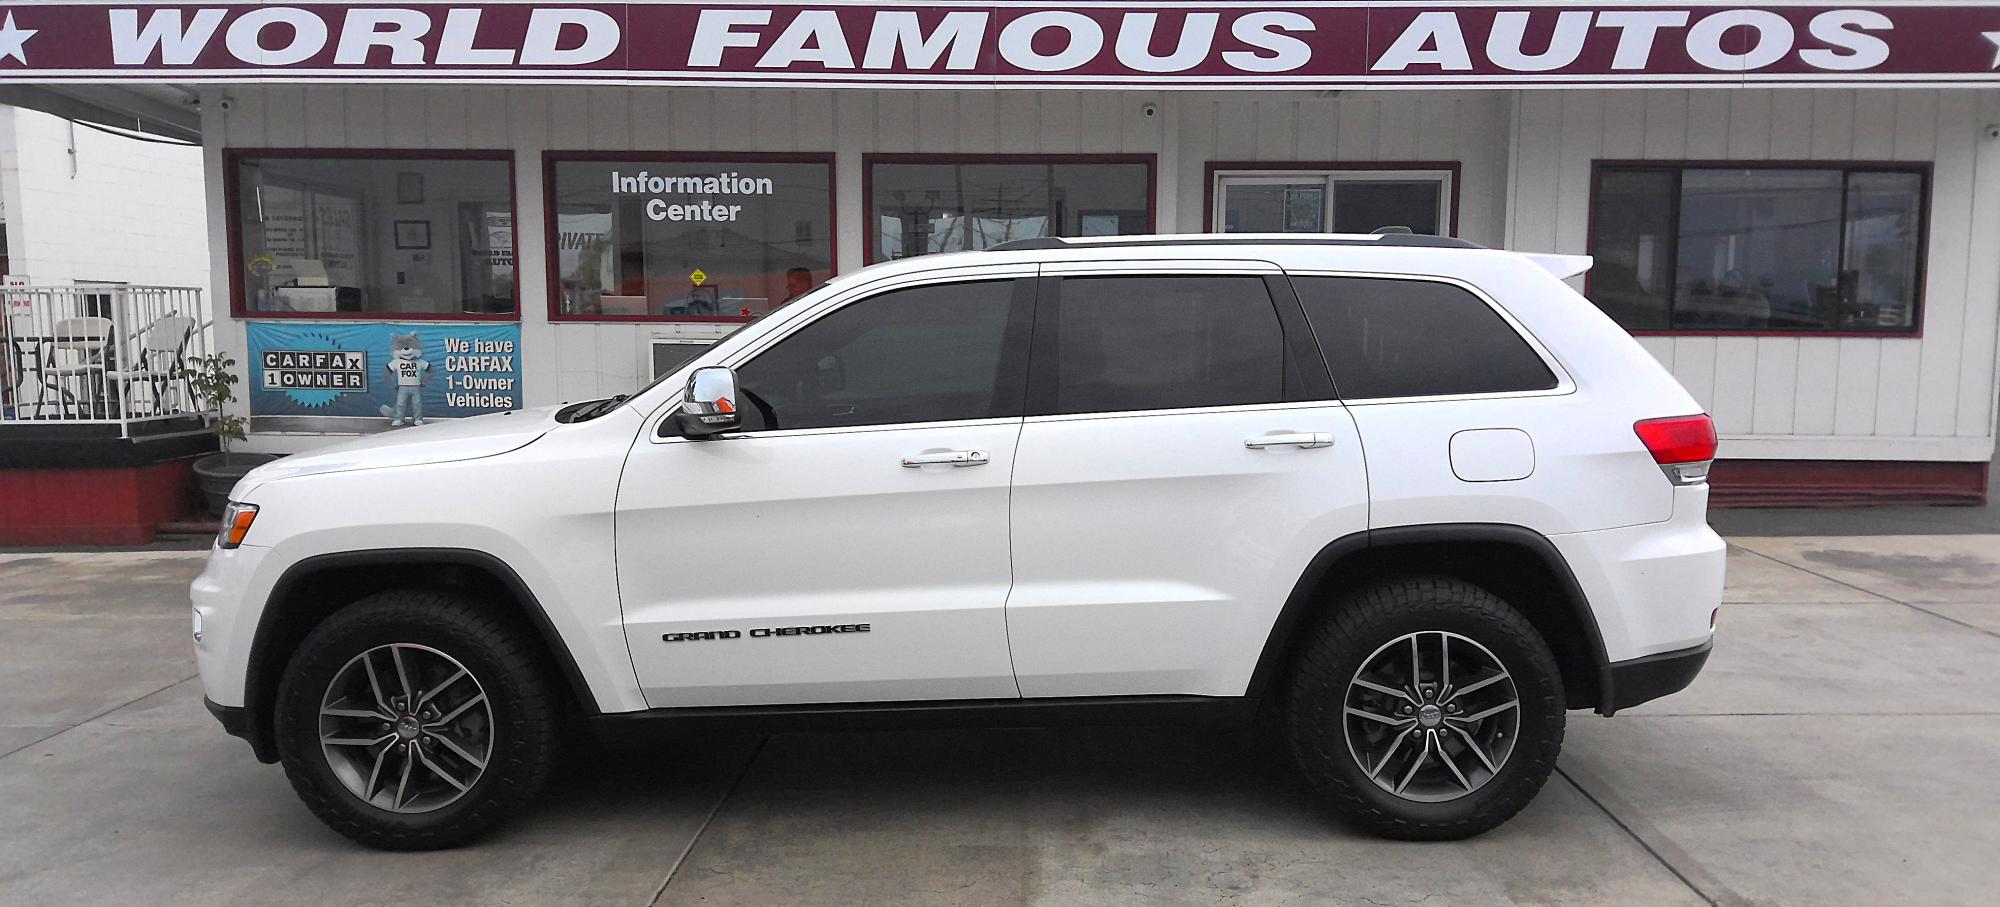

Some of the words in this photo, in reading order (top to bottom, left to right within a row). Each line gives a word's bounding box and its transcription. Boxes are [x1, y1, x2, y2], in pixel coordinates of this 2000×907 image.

[108, 8, 620, 66] WORLD
[687, 9, 1315, 73] FAMOUS
[1371, 9, 1895, 72] AUTOS
[611, 171, 774, 195] Information
[646, 199, 742, 222] Center
[445, 338, 469, 353] We
[475, 338, 513, 353] have
[264, 353, 361, 370] CARFAX
[445, 355, 513, 372] CARFAX
[447, 375, 514, 390] 1-Owner
[446, 393, 513, 408] Vehicles
[662, 630, 741, 642] GRAND
[749, 623, 871, 637] CHEROKEE
